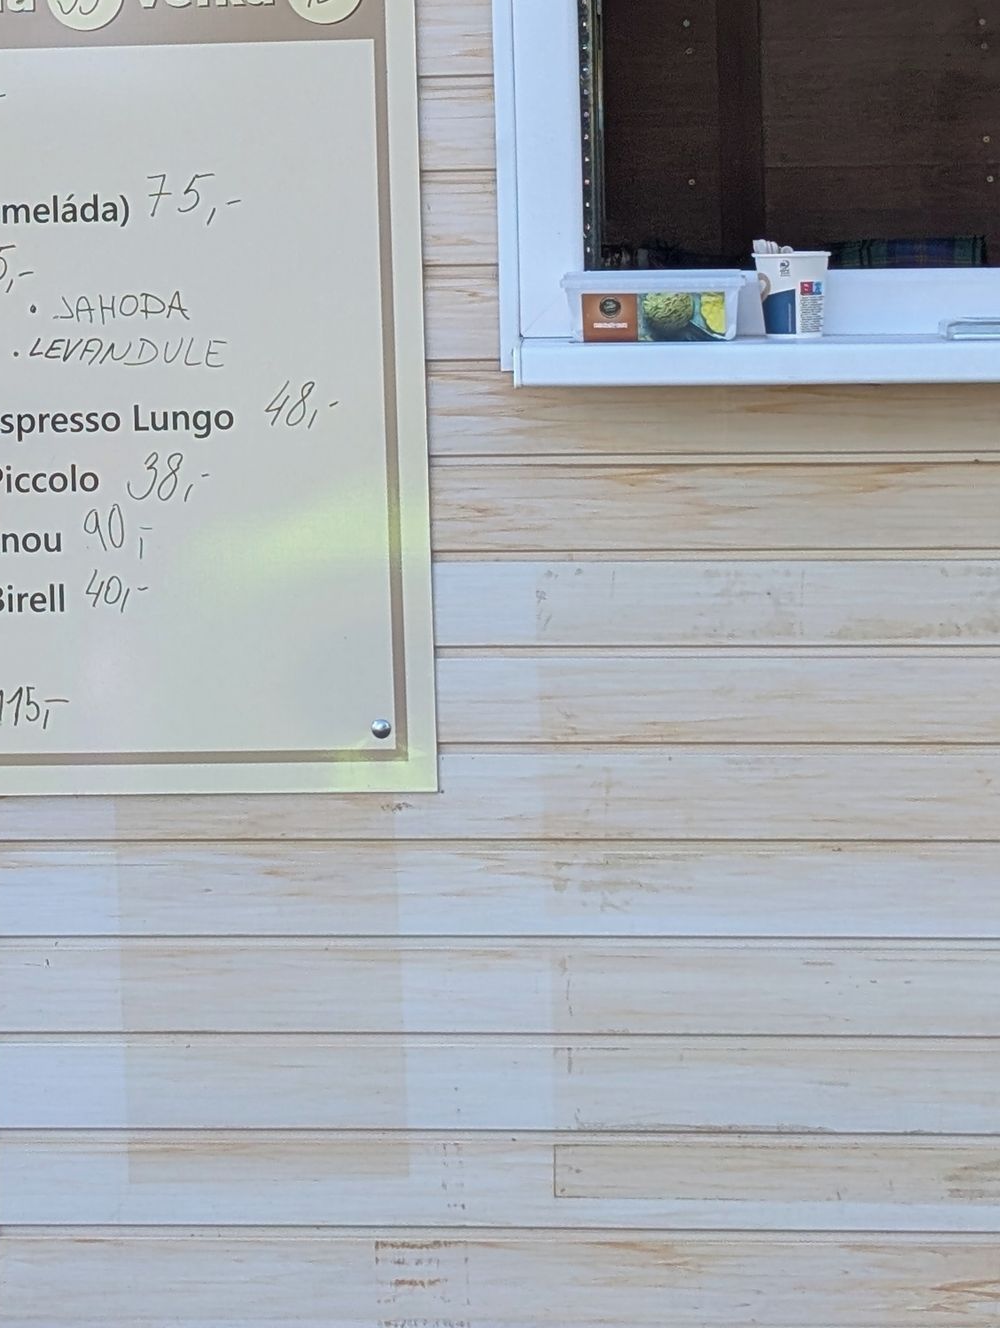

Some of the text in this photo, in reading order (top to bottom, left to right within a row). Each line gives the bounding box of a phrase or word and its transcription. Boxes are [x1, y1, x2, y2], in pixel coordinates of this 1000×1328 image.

[146, 172, 243, 226] 75,-
[52, 291, 190, 323] JAHODA
[29, 337, 228, 368] LEVANDULE
[133, 404, 235, 439] Lungo
[263, 380, 340, 430] 48,-
[126, 451, 211, 503] 38,-
[84, 569, 150, 613] 40,-
